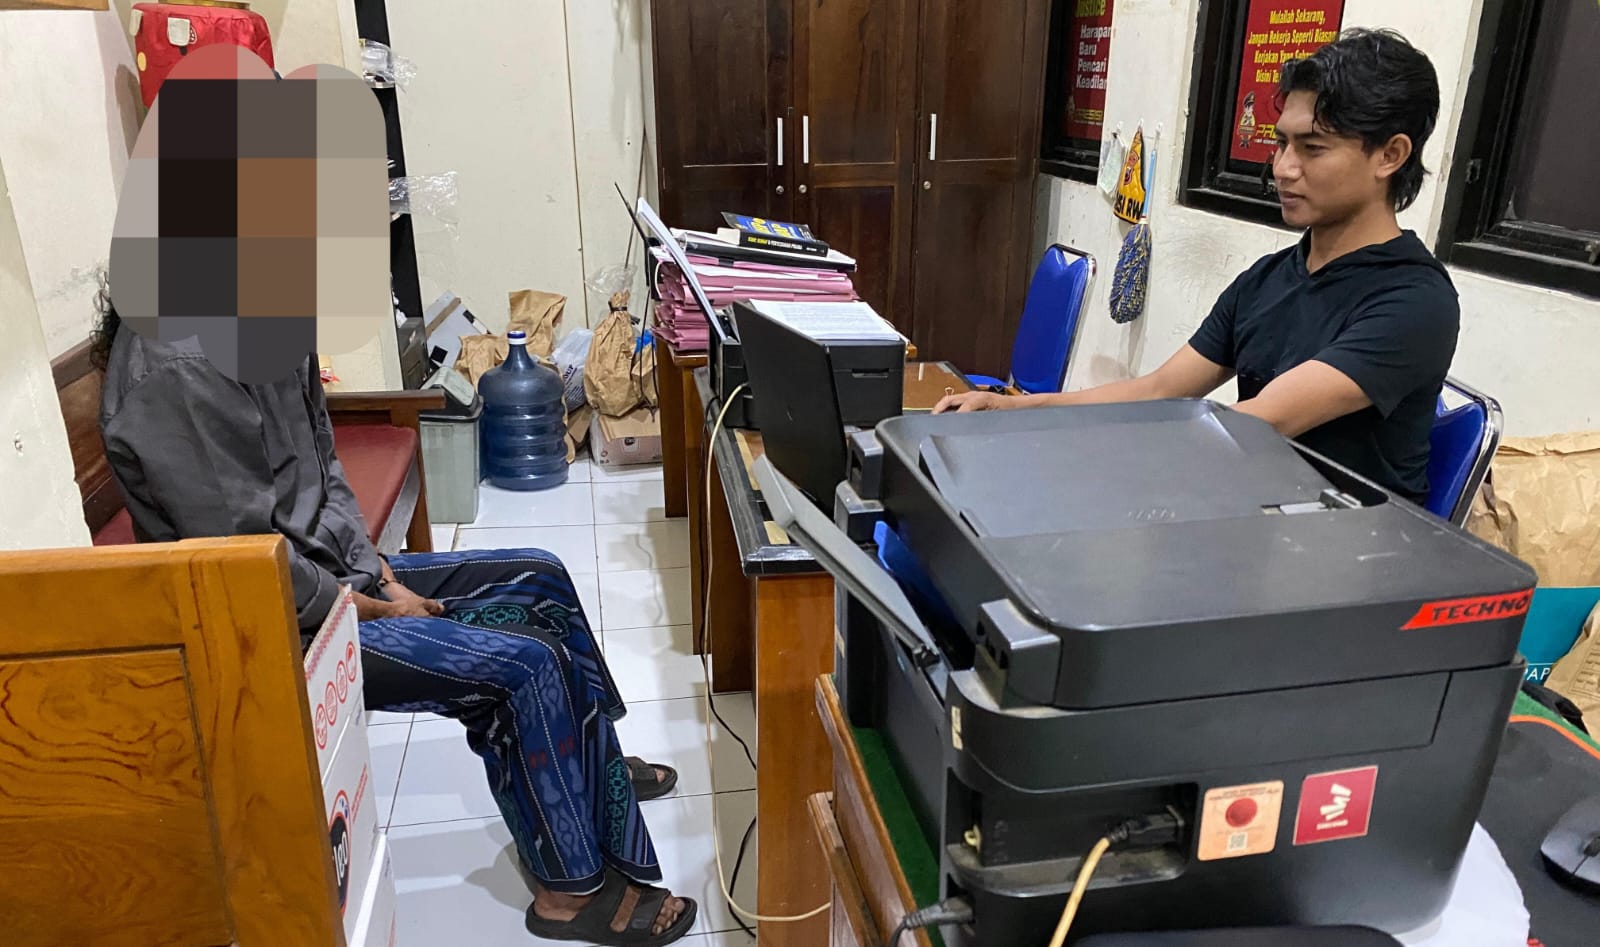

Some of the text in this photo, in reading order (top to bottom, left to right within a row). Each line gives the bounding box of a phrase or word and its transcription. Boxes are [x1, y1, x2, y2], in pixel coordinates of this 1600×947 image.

[1295, 8, 1325, 24] Sekarang,
[1248, 31, 1268, 47] Jangan
[1269, 30, 1290, 46] Bekerja
[1292, 29, 1314, 46] Seperti
[1079, 41, 1097, 56] Baru
[1078, 58, 1106, 72] Pencari
[1254, 50, 1278, 66] Kerjakan
[1432, 594, 1529, 621] TECHNO
